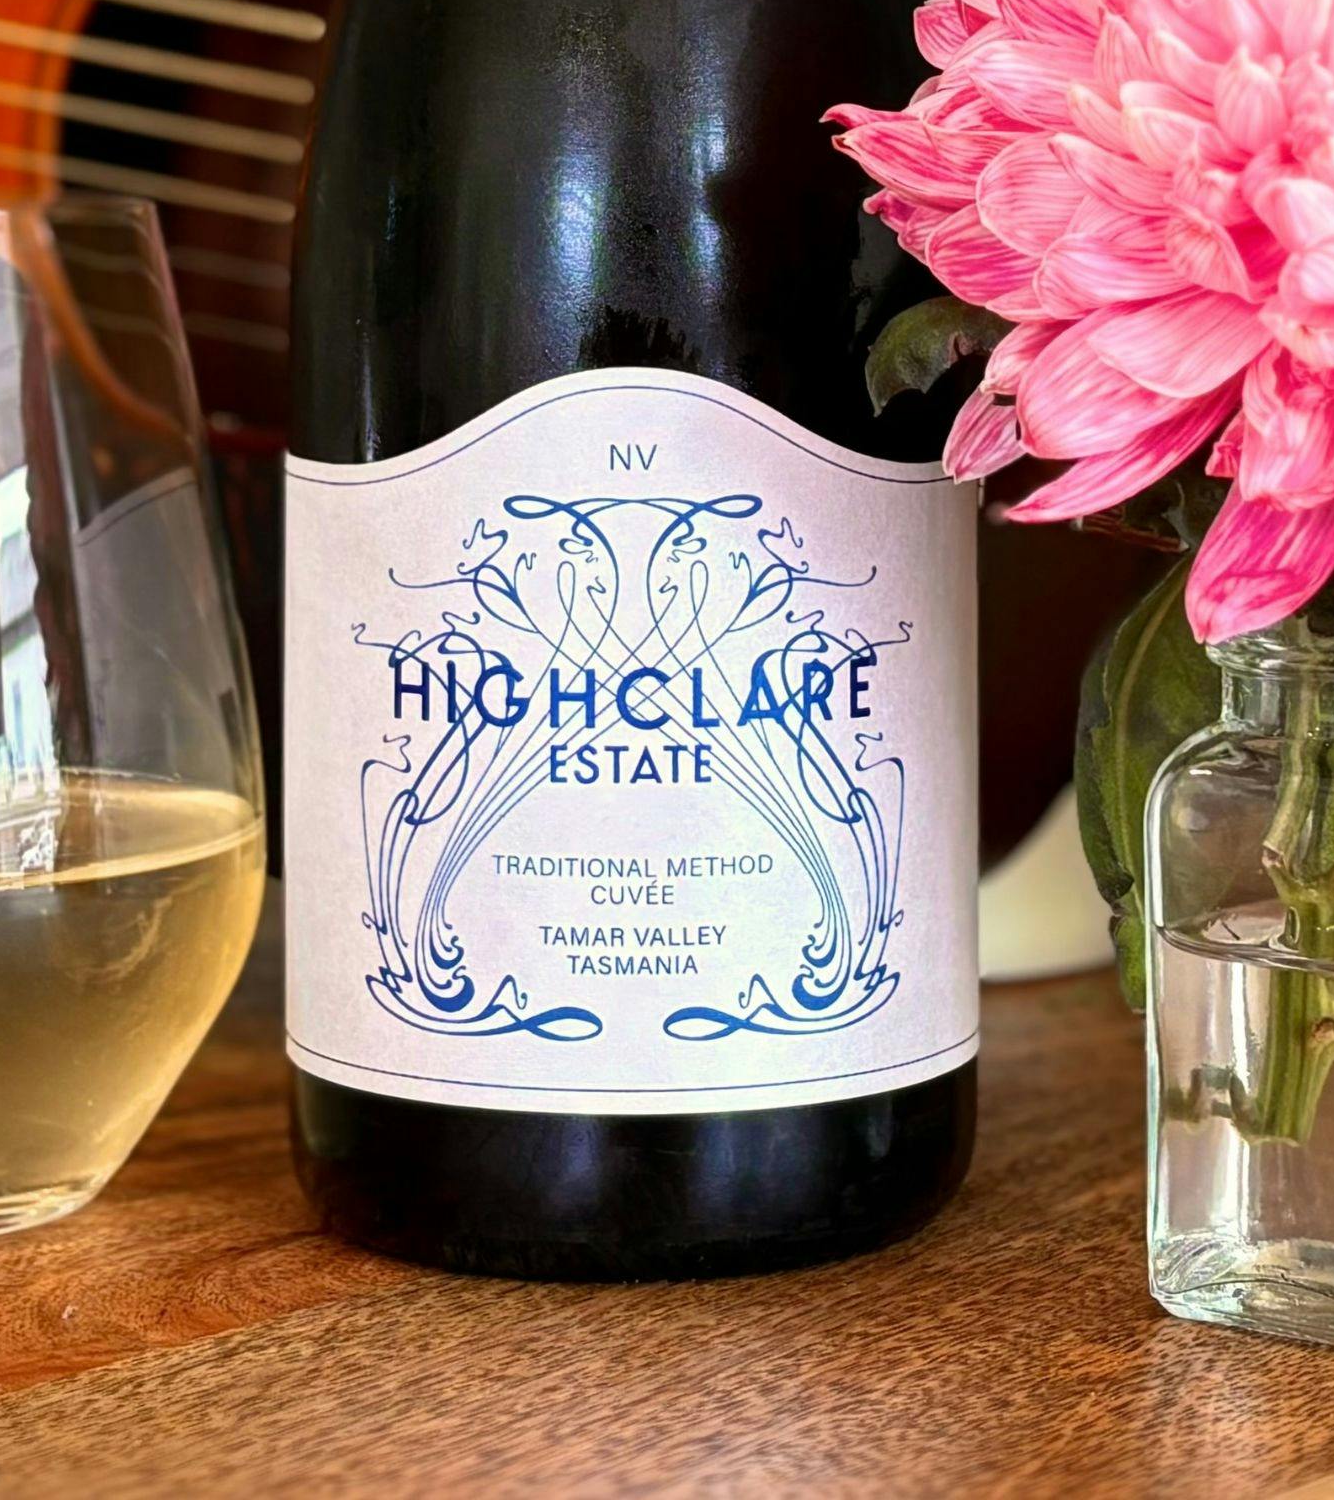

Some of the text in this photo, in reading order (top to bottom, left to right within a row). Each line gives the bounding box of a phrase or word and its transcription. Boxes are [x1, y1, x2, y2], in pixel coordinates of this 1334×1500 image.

[609, 443, 658, 471] NV
[392, 653, 876, 731] HIGHCLARE
[549, 742, 714, 785] ESTATE
[491, 853, 774, 880] TRADITIONAL METHOD
[590, 879, 674, 906] CUVÉE
[538, 925, 727, 948] TAMAR VALLEY
[568, 954, 699, 976] TASMANIA
